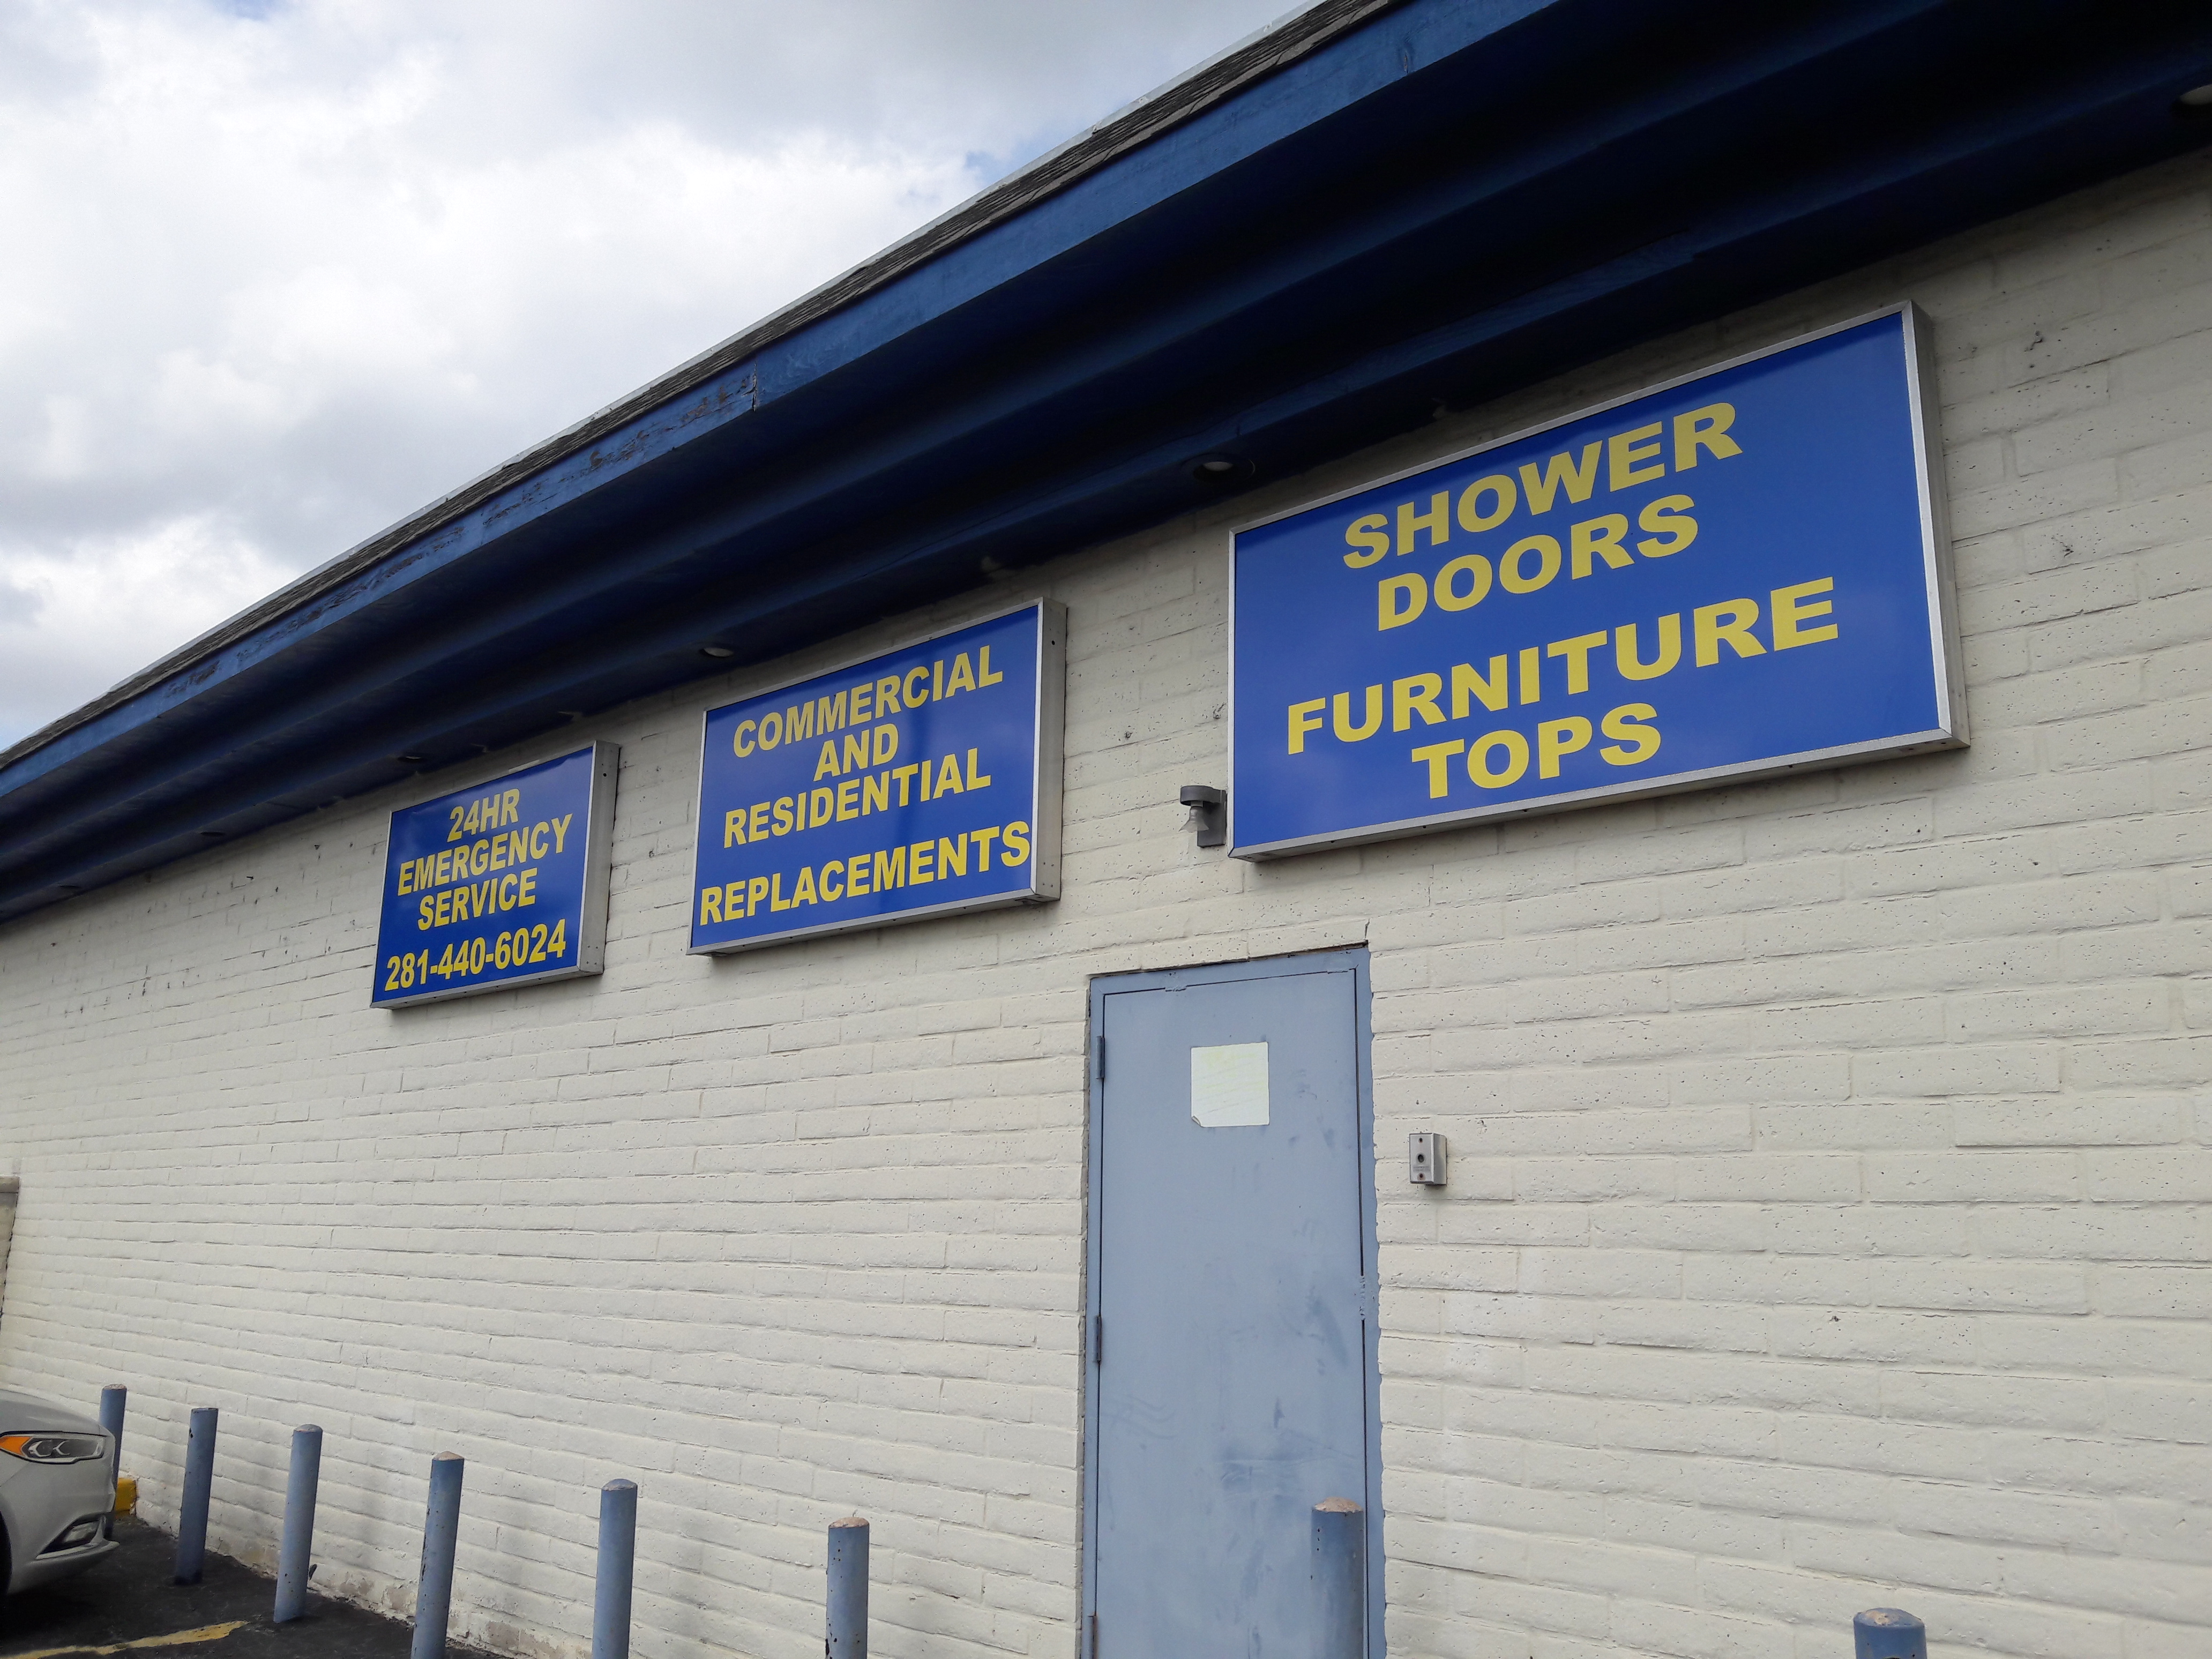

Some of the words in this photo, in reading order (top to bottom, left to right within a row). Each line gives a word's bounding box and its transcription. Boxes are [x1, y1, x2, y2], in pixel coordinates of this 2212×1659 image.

[1343, 402, 1743, 569] SHOWER
[1378, 494, 1698, 631] DOORS
[734, 645, 1003, 758] COMMERCIAL
[1288, 577, 1839, 754] FURNITURE
[724, 748, 991, 848] RESIDENTIAL
[813, 723, 899, 781] AND
[1411, 703, 1661, 799] TOPS
[398, 814, 573, 896] EMERGENCY
[447, 788, 520, 842] 24HR
[417, 868, 537, 931] SERVICE
[700, 820, 1030, 925] REPLACEMENTS
[385, 918, 566, 991] 281-440-6024
